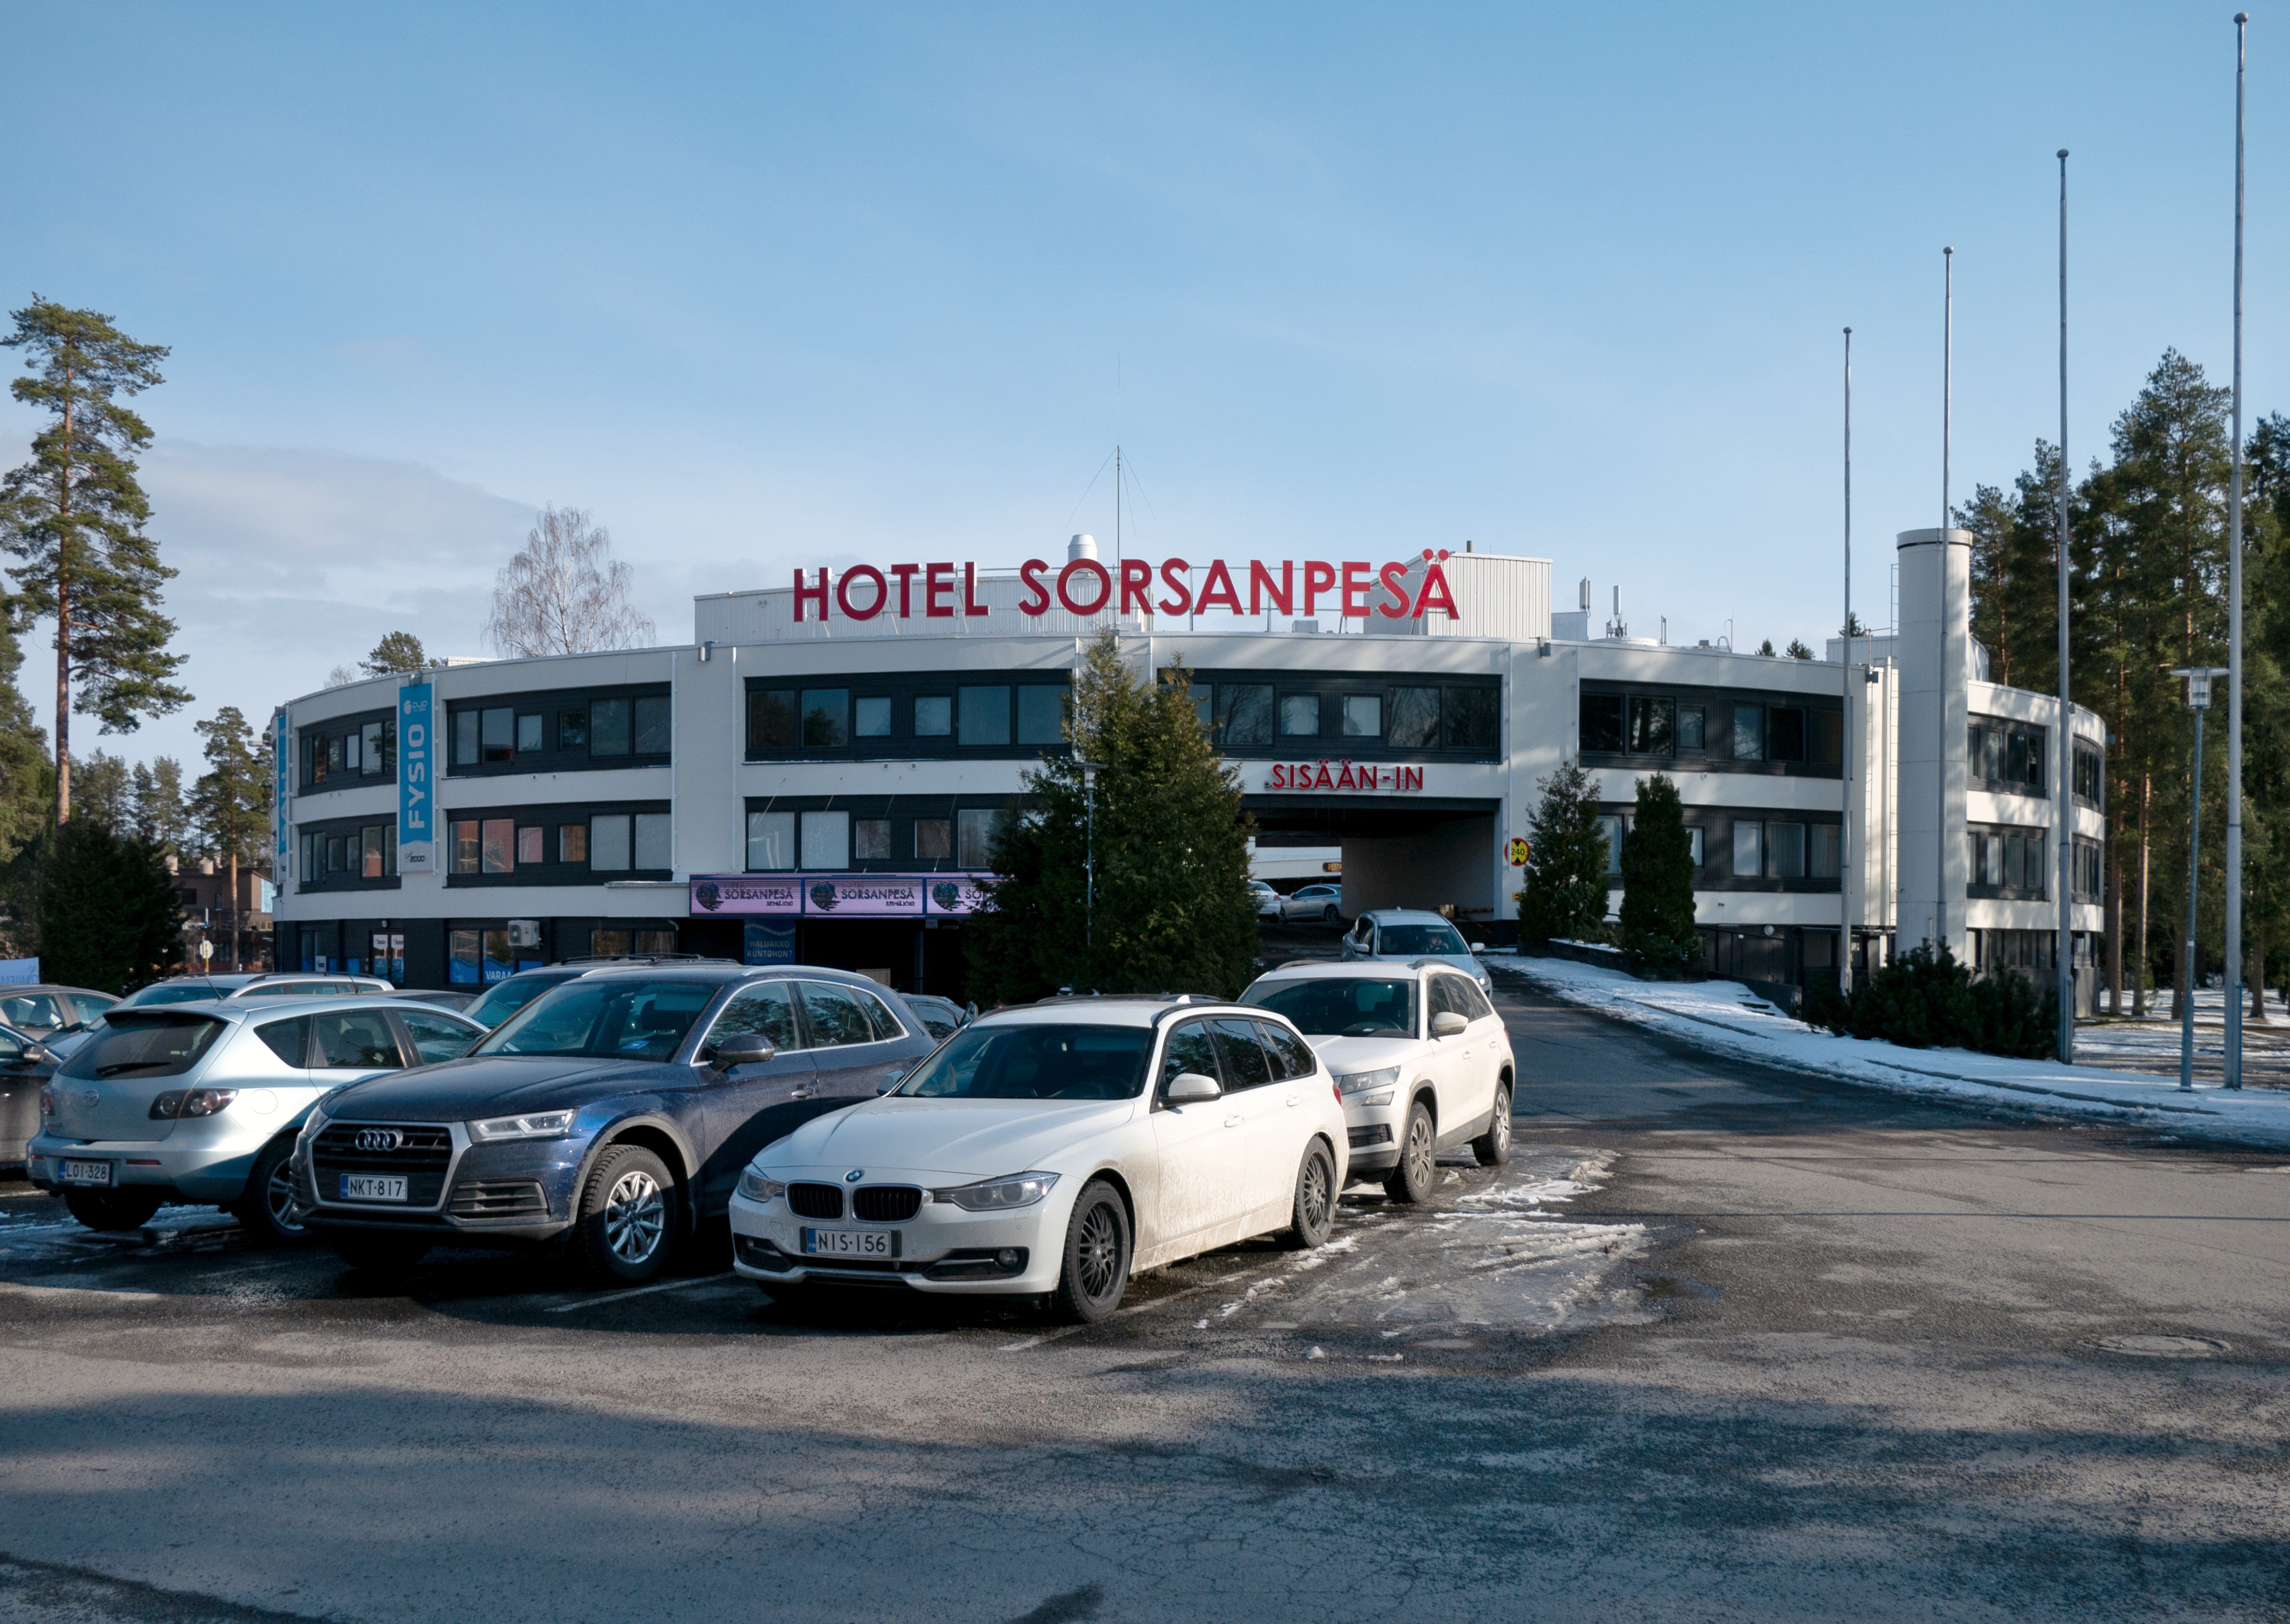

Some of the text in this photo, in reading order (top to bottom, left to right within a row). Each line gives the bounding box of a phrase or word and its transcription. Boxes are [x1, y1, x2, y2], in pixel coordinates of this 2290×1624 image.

[794, 548, 1460, 622] HOTEL SORSANPESÄ
[408, 724, 425, 829] FYSIO
[1271, 758, 1423, 790] SISÄÄN-IN
[725, 887, 793, 899] SORSANPESÄ
[842, 887, 914, 899] SORSANPESÄ
[486, 971, 512, 980] VARAA
[66, 1163, 107, 1179] LOI-328
[350, 1179, 402, 1196] NKT-817
[819, 1233, 885, 1252] NIS-156
